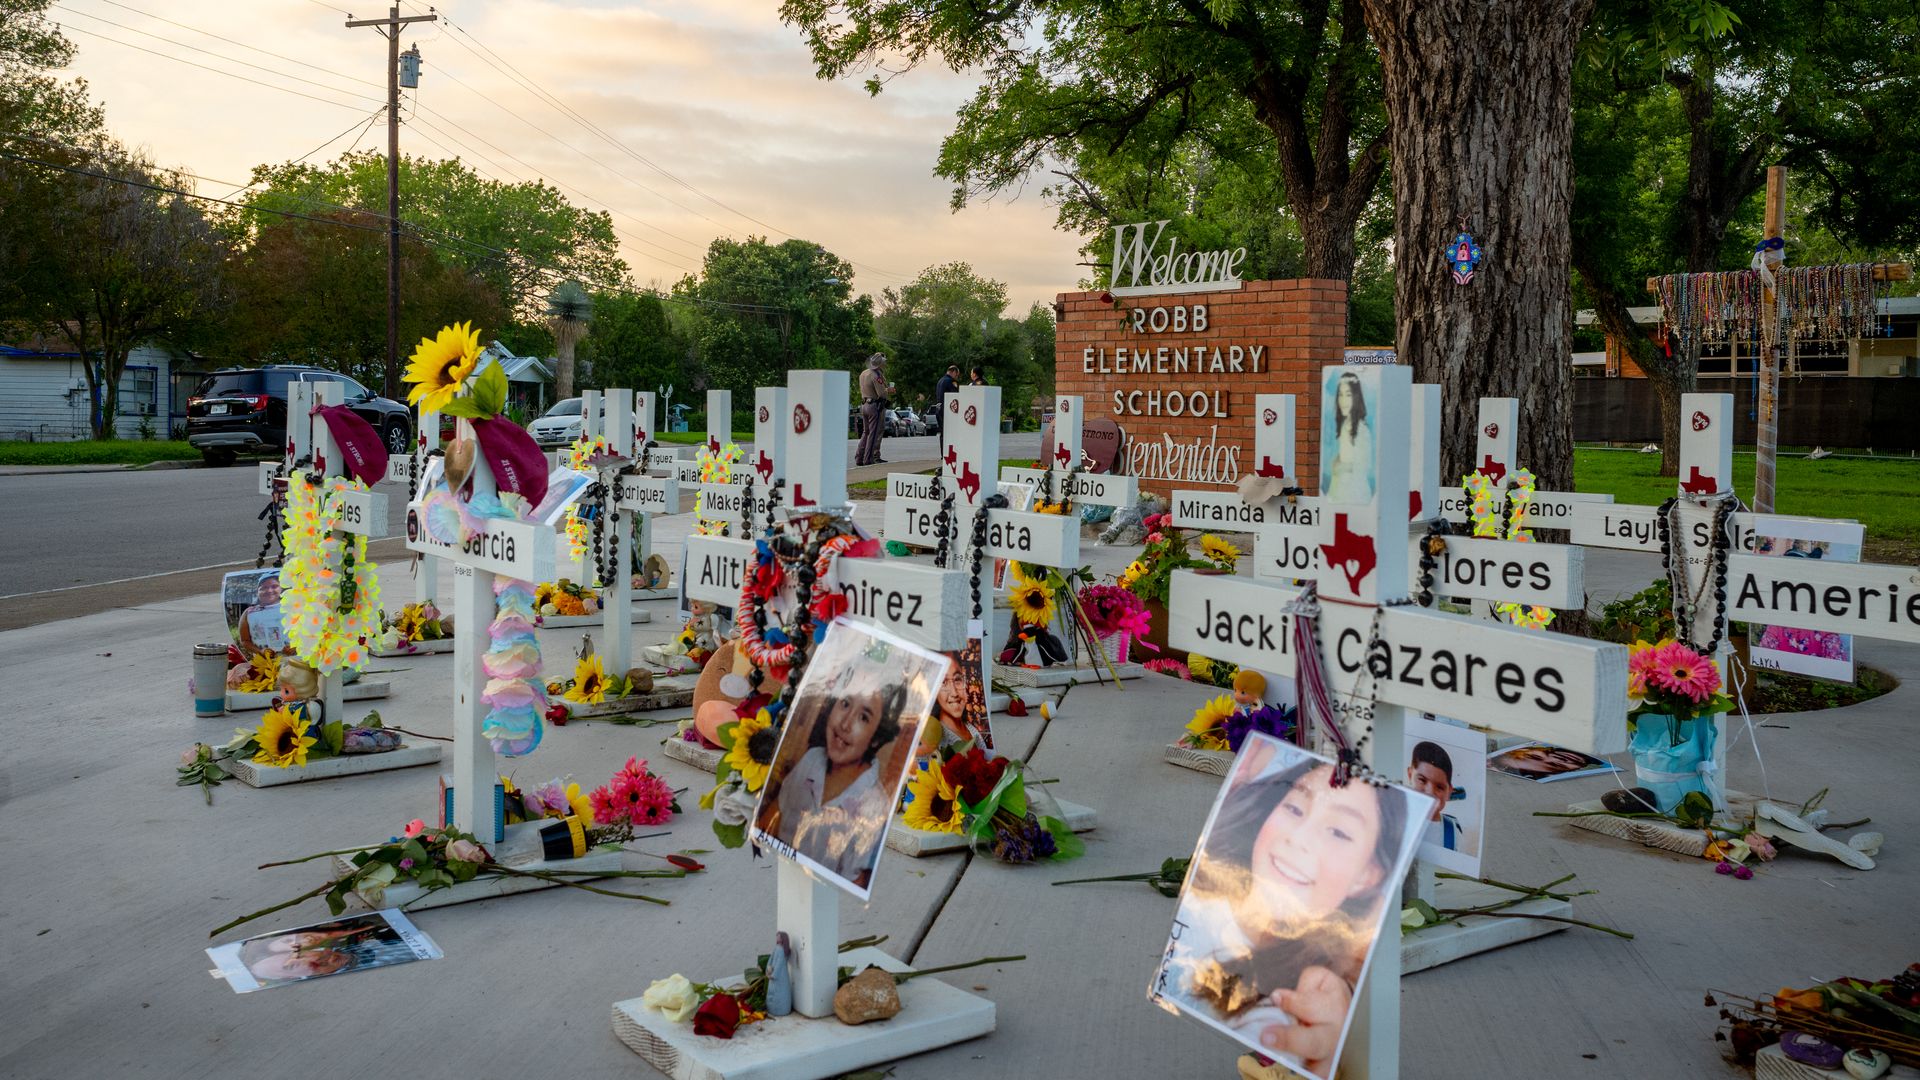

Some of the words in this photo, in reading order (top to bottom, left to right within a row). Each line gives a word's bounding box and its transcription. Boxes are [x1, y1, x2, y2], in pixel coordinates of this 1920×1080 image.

[1110, 219, 1247, 288] Welcome
[1132, 304, 1208, 334] ROBB
[1083, 345, 1264, 374] ELEMENTARY
[1112, 389, 1228, 418] SCHOOL
[1082, 429, 1114, 441] STRONG
[614, 484, 665, 505] odriguez
[1179, 500, 1265, 523] Miranda
[1605, 515, 1657, 545] Layl
[1433, 551, 1552, 591] lores
[1197, 599, 1289, 655] Jacki
[1337, 627, 1566, 713] Cazares
